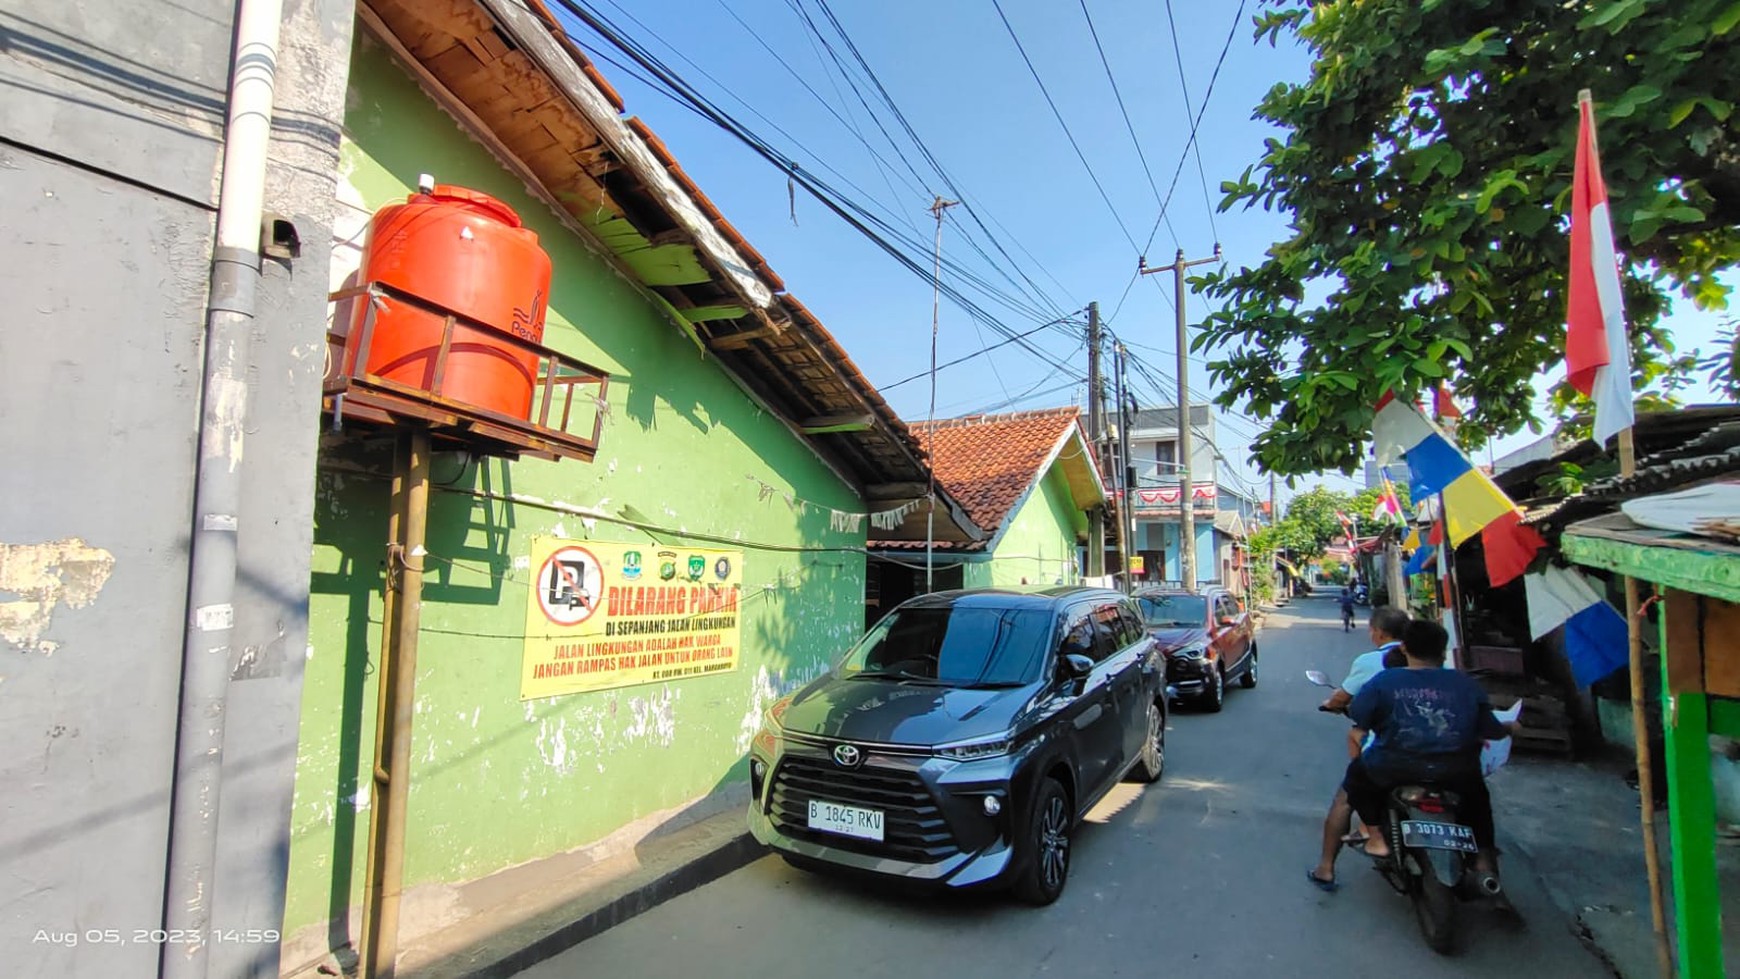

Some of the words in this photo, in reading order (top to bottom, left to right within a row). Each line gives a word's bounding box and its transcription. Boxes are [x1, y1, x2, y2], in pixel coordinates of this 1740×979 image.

[607, 586, 686, 617] DILARANG
[690, 585, 738, 614] PARKIR
[606, 621, 615, 636] DI
[618, 619, 666, 636] SEPANJANG
[667, 618, 690, 633] JALAN
[692, 616, 736, 631] LINGKUNGAN
[554, 644, 584, 660] JALAN
[586, 639, 644, 657] LINGKUNGAN
[646, 638, 676, 652] ADALAH
[678, 636, 694, 648] HAK
[696, 634, 721, 647] WARGA
[532, 662, 574, 680] JANGAN
[576, 657, 616, 674] RAMPAS
[618, 655, 636, 670] HAK
[638, 653, 662, 668] JALAN
[664, 651, 690, 664] UNTUK
[692, 649, 716, 662] ORANG
[718, 646, 733, 658] LAIN
[810, 803, 818, 818] B
[825, 806, 854, 824] 1845
[858, 812, 881, 829] RKV
[1402, 824, 1411, 834] B
[1416, 824, 1444, 836] 3073
